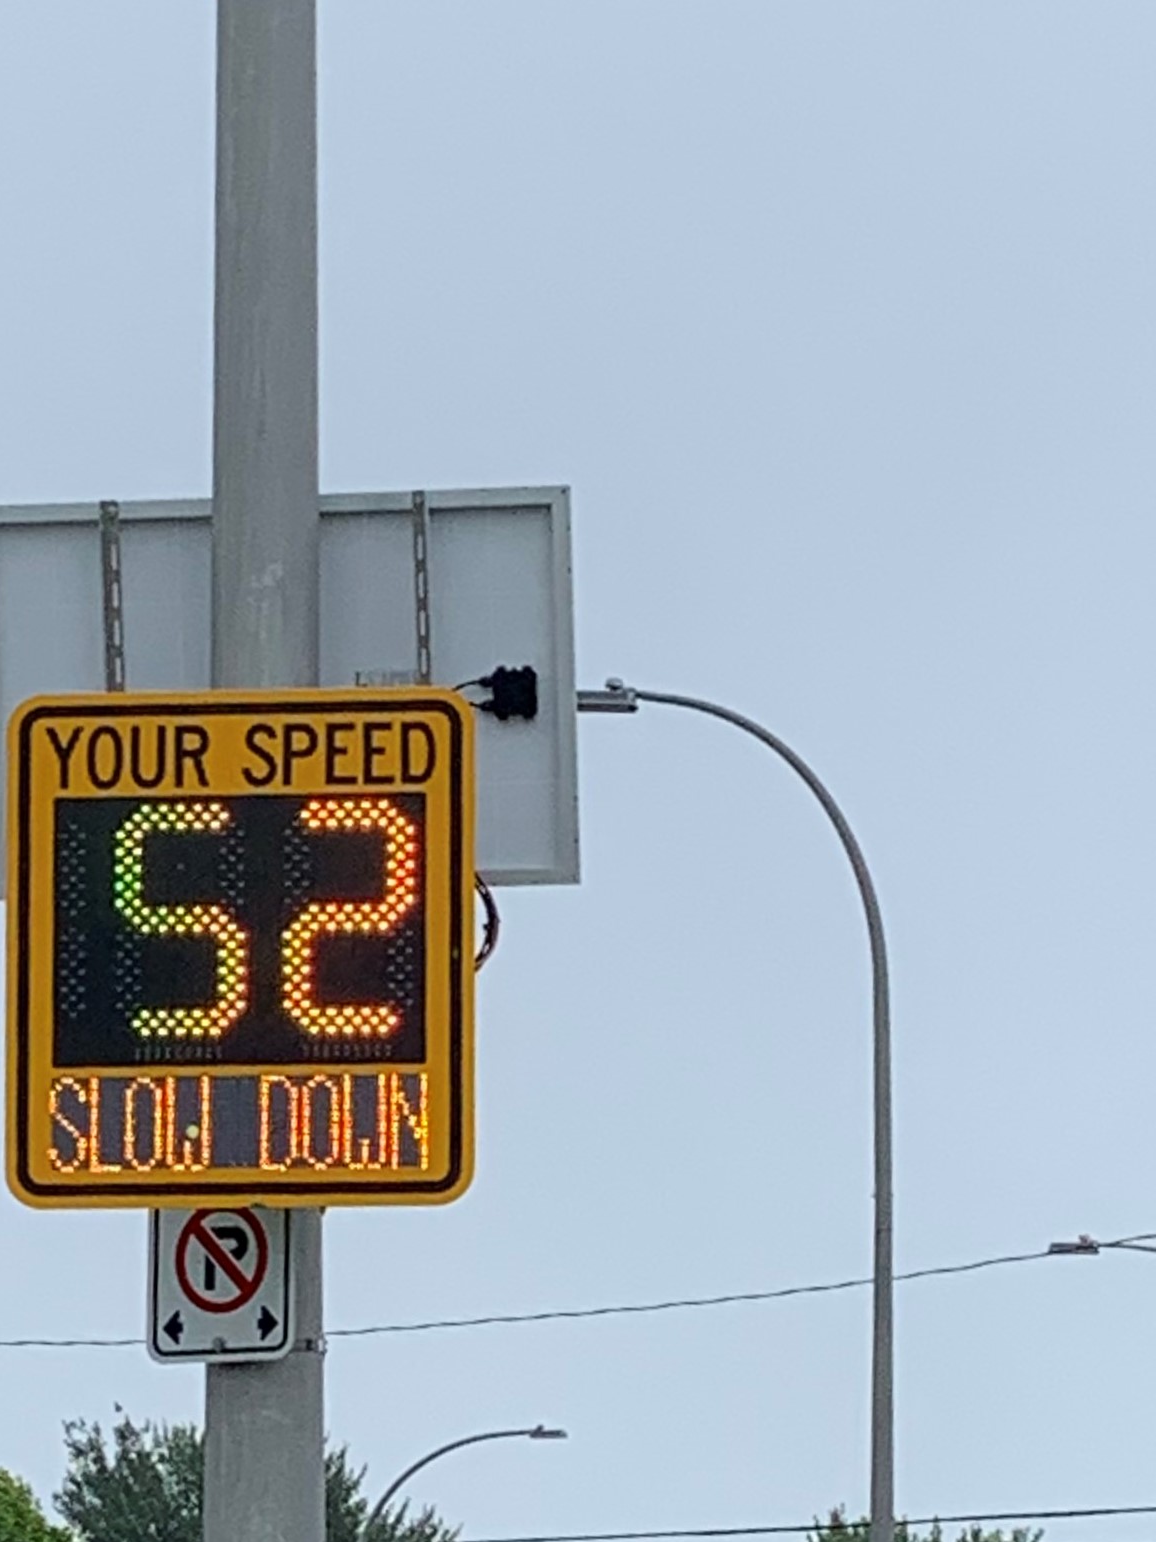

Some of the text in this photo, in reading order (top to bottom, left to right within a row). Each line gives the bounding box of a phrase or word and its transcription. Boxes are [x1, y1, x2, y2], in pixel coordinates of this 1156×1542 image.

[46, 722, 437, 790] YOUR SPEED
[114, 800, 417, 1037] 52
[49, 1073, 428, 1172] SLOW DOWN
